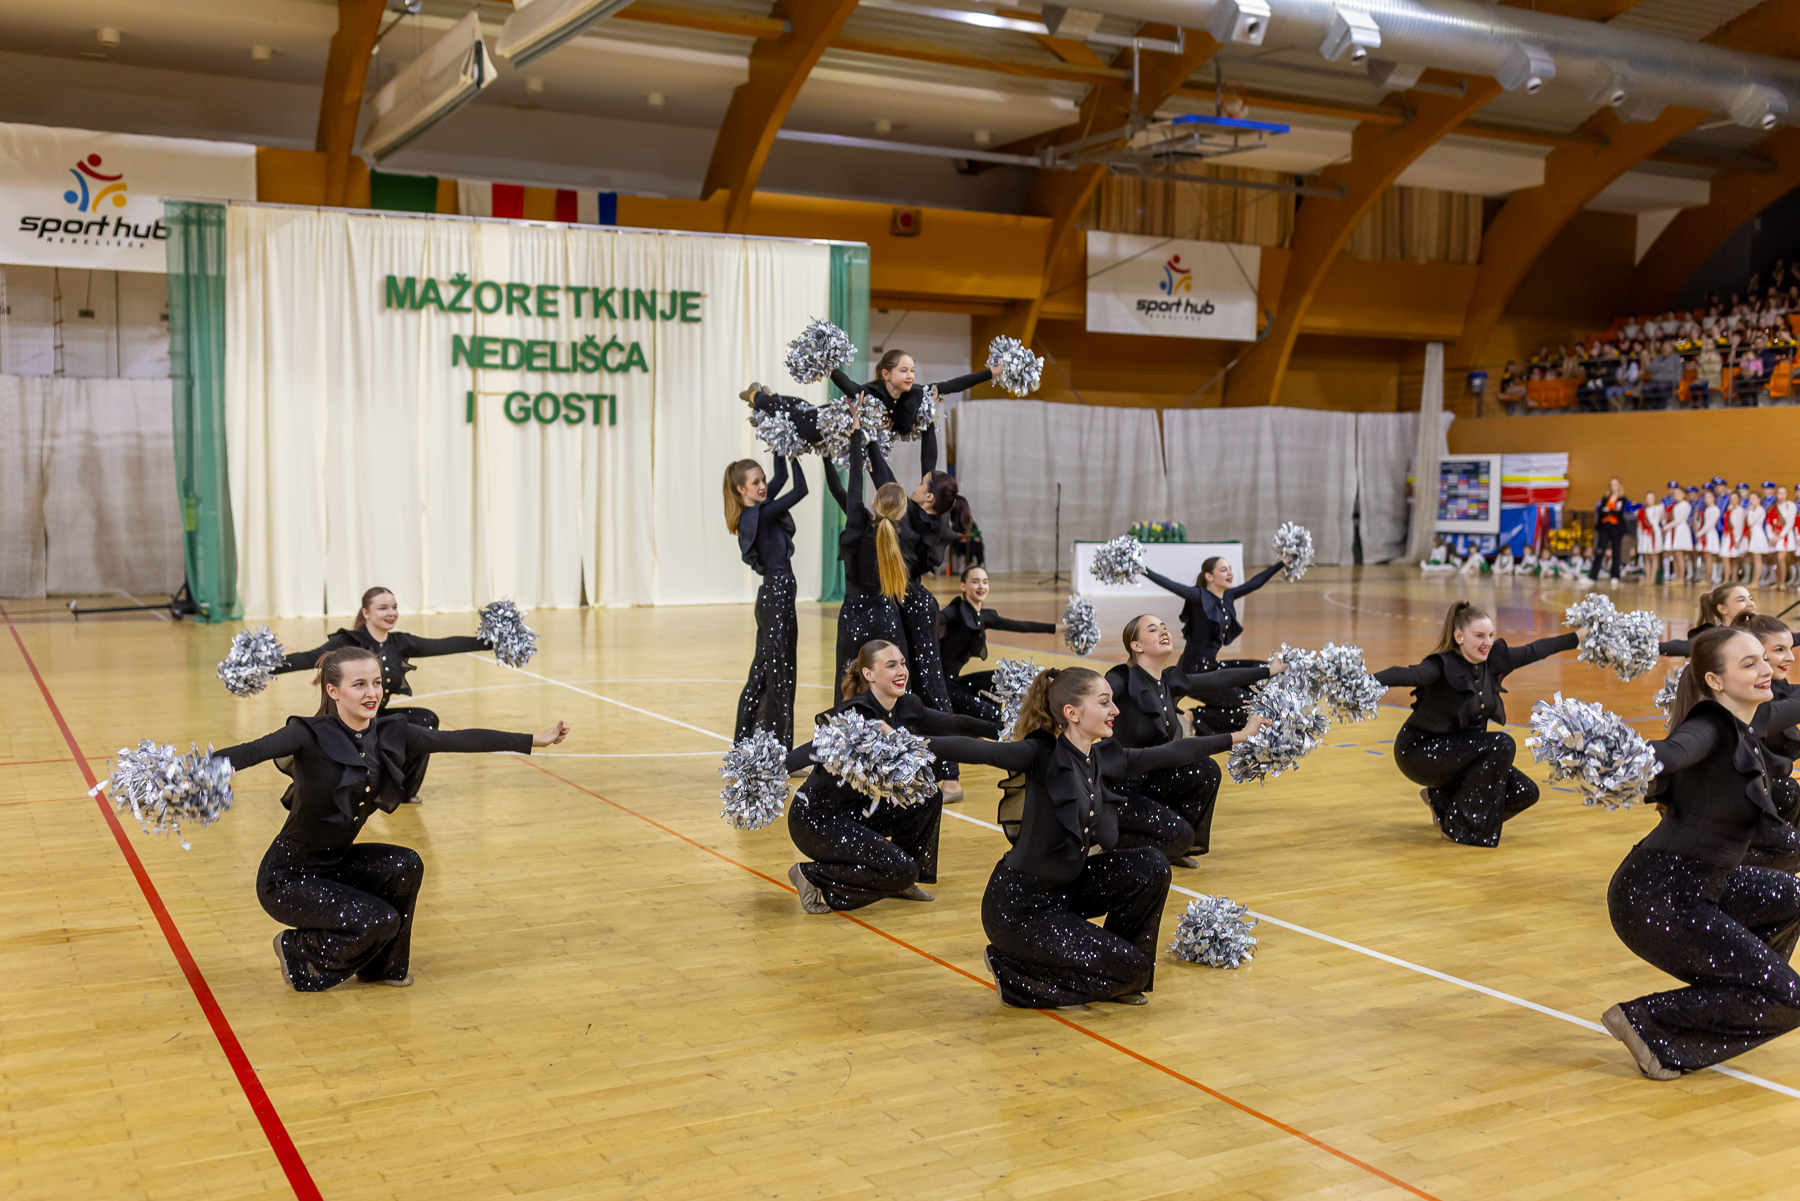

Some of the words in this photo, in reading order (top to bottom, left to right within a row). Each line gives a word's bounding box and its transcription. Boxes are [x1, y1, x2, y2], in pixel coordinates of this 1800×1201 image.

[19, 214, 109, 238] sport
[113, 215, 172, 240] hub
[385, 273, 702, 322] MAŽORETKINJE
[1136, 297, 1182, 315] sport
[1184, 298, 1215, 316] hub
[452, 335, 648, 373] NEDELIŠĆA
[466, 391, 474, 424] I
[504, 391, 618, 426] GOSTI
